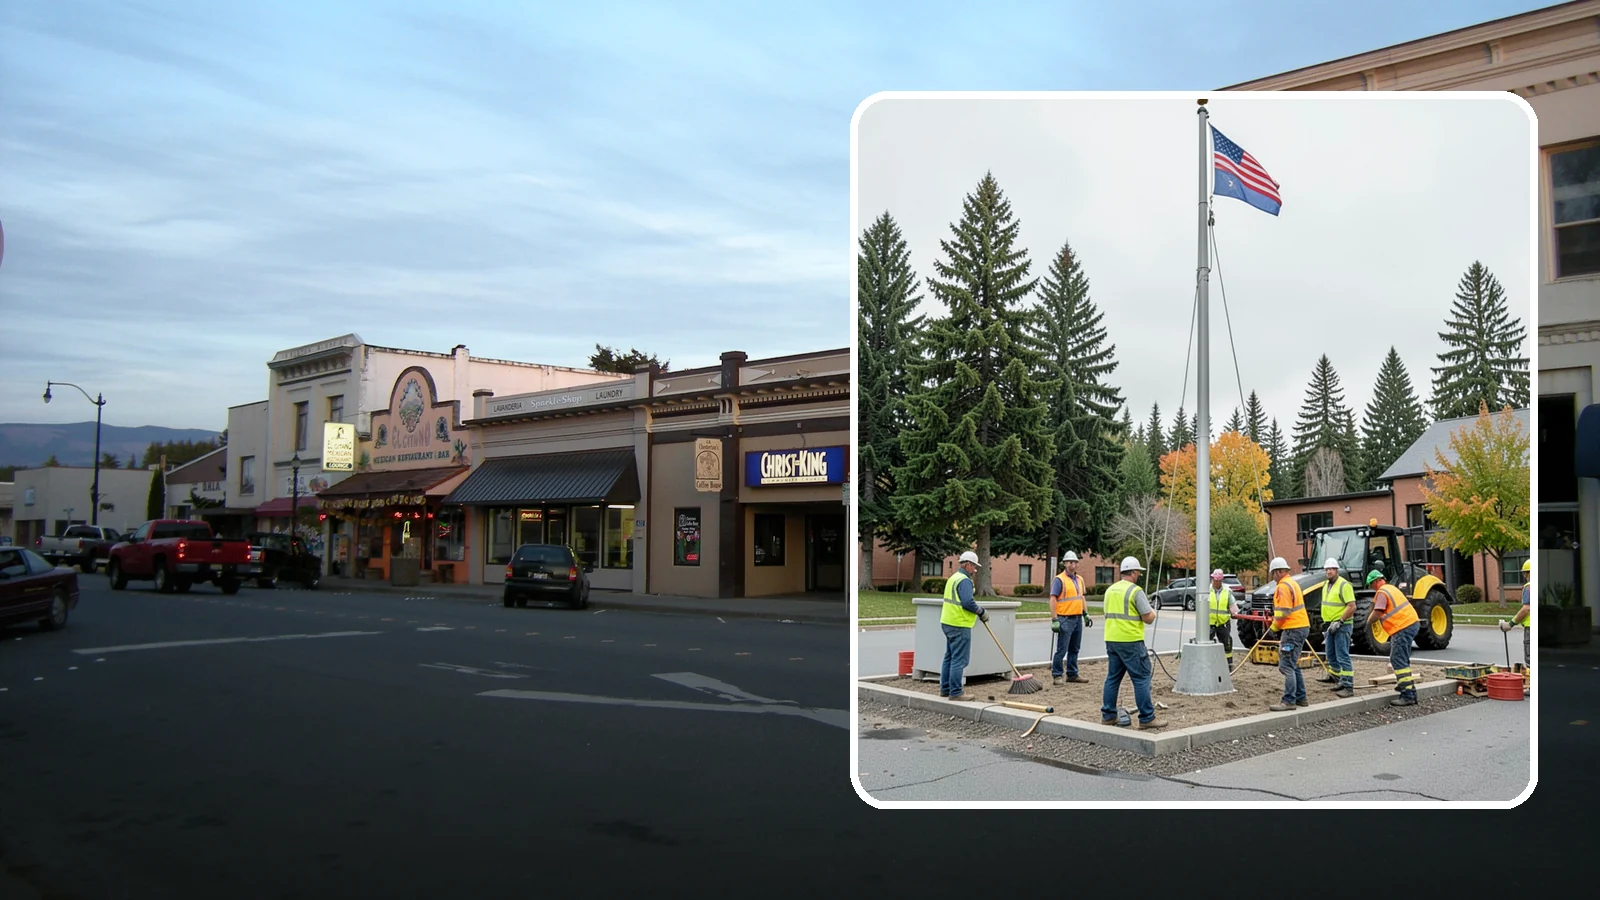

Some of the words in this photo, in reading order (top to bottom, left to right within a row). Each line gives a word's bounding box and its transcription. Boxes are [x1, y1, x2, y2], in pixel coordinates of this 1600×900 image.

[531, 396, 561, 408] Sparkle
[561, 394, 583, 405] Shop
[595, 389, 623, 400] LAUNDRY
[493, 402, 522, 412] LAVANDERIA
[373, 455, 396, 464] MEXICAN
[397, 451, 433, 462] RESTAURANT
[438, 450, 450, 458] BAR
[761, 452, 797, 477] CHRIST
[800, 450, 827, 476] KING
